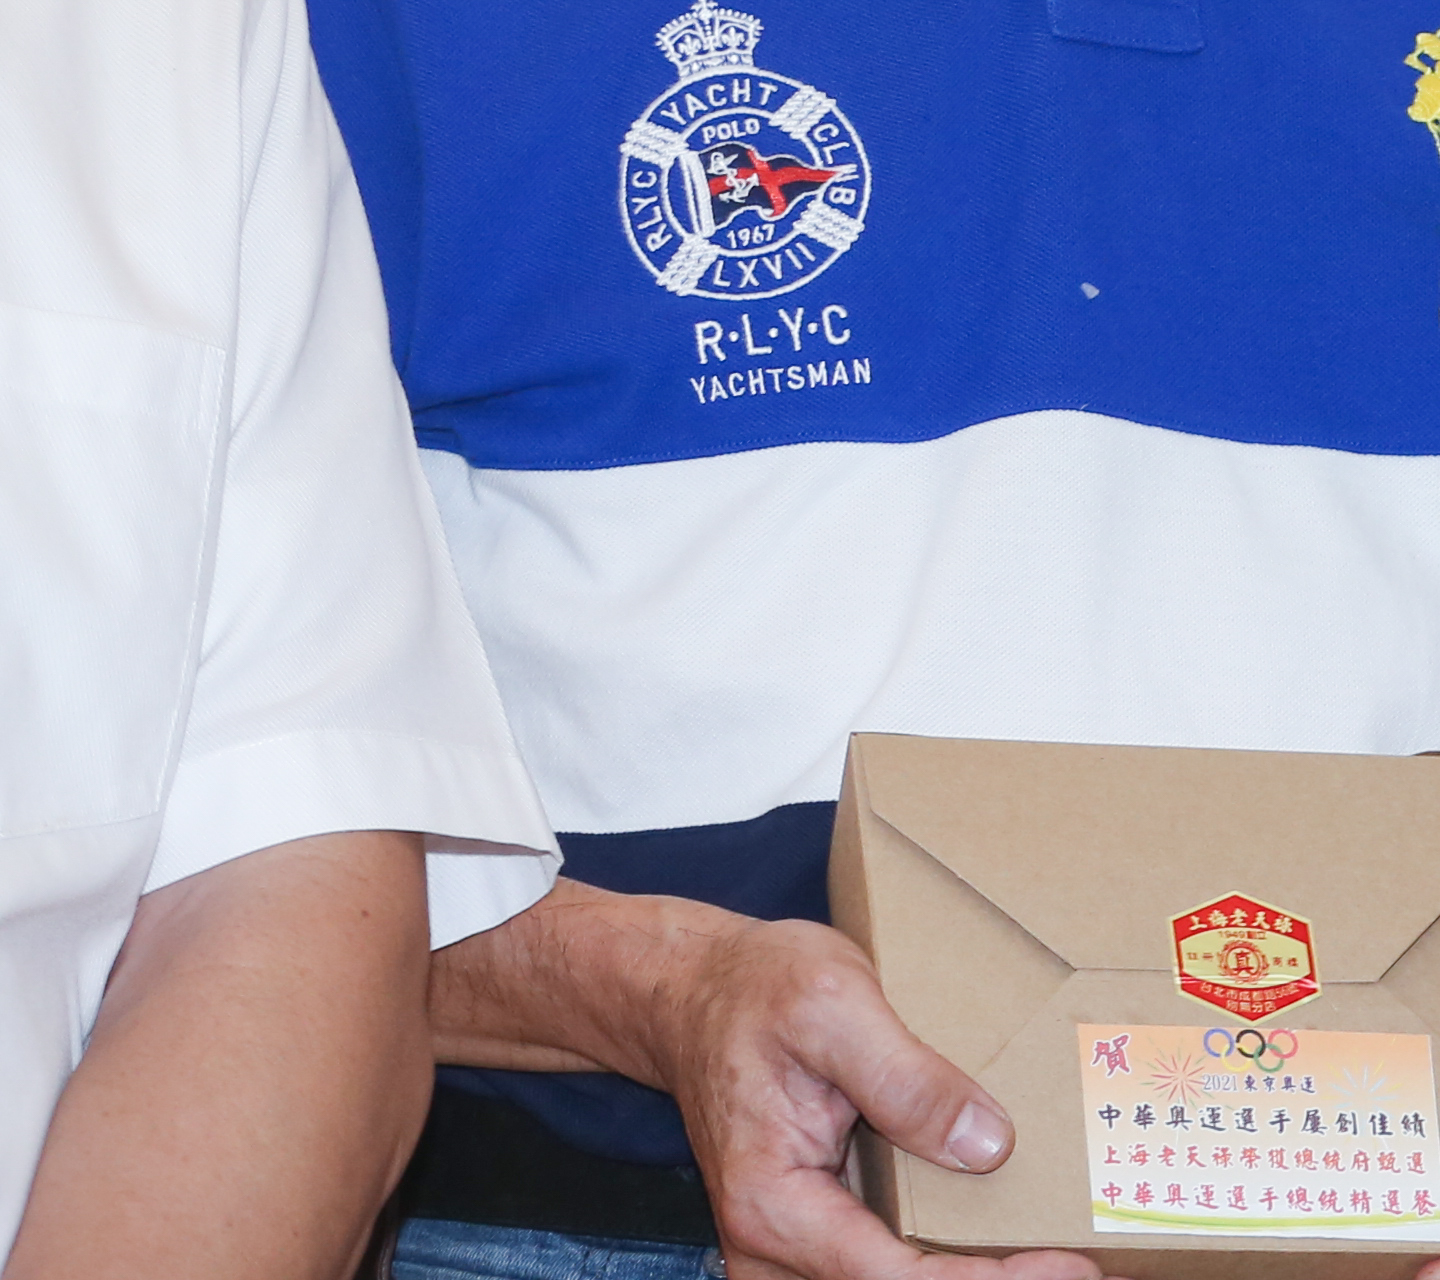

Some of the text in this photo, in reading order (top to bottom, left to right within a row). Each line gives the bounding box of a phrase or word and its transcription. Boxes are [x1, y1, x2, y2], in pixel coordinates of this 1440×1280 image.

[660, 78, 779, 126] YACHT
[702, 117, 761, 145] POLO
[630, 170, 673, 252] RLYC
[726, 222, 776, 250] 1967
[712, 241, 817, 289] LXVII
[689, 357, 873, 405] YACHTSMAN
[1188, 908, 1294, 934] 上海老天祿
[1091, 1034, 1132, 1077] 賀
[1096, 1104, 1428, 1138] 中華奧運選手屢創佳績
[1102, 1142, 1428, 1176] 上海老天祿榮獲總統府甄選
[1100, 1180, 1440, 1218] 中華奧運選手總統精選餐
